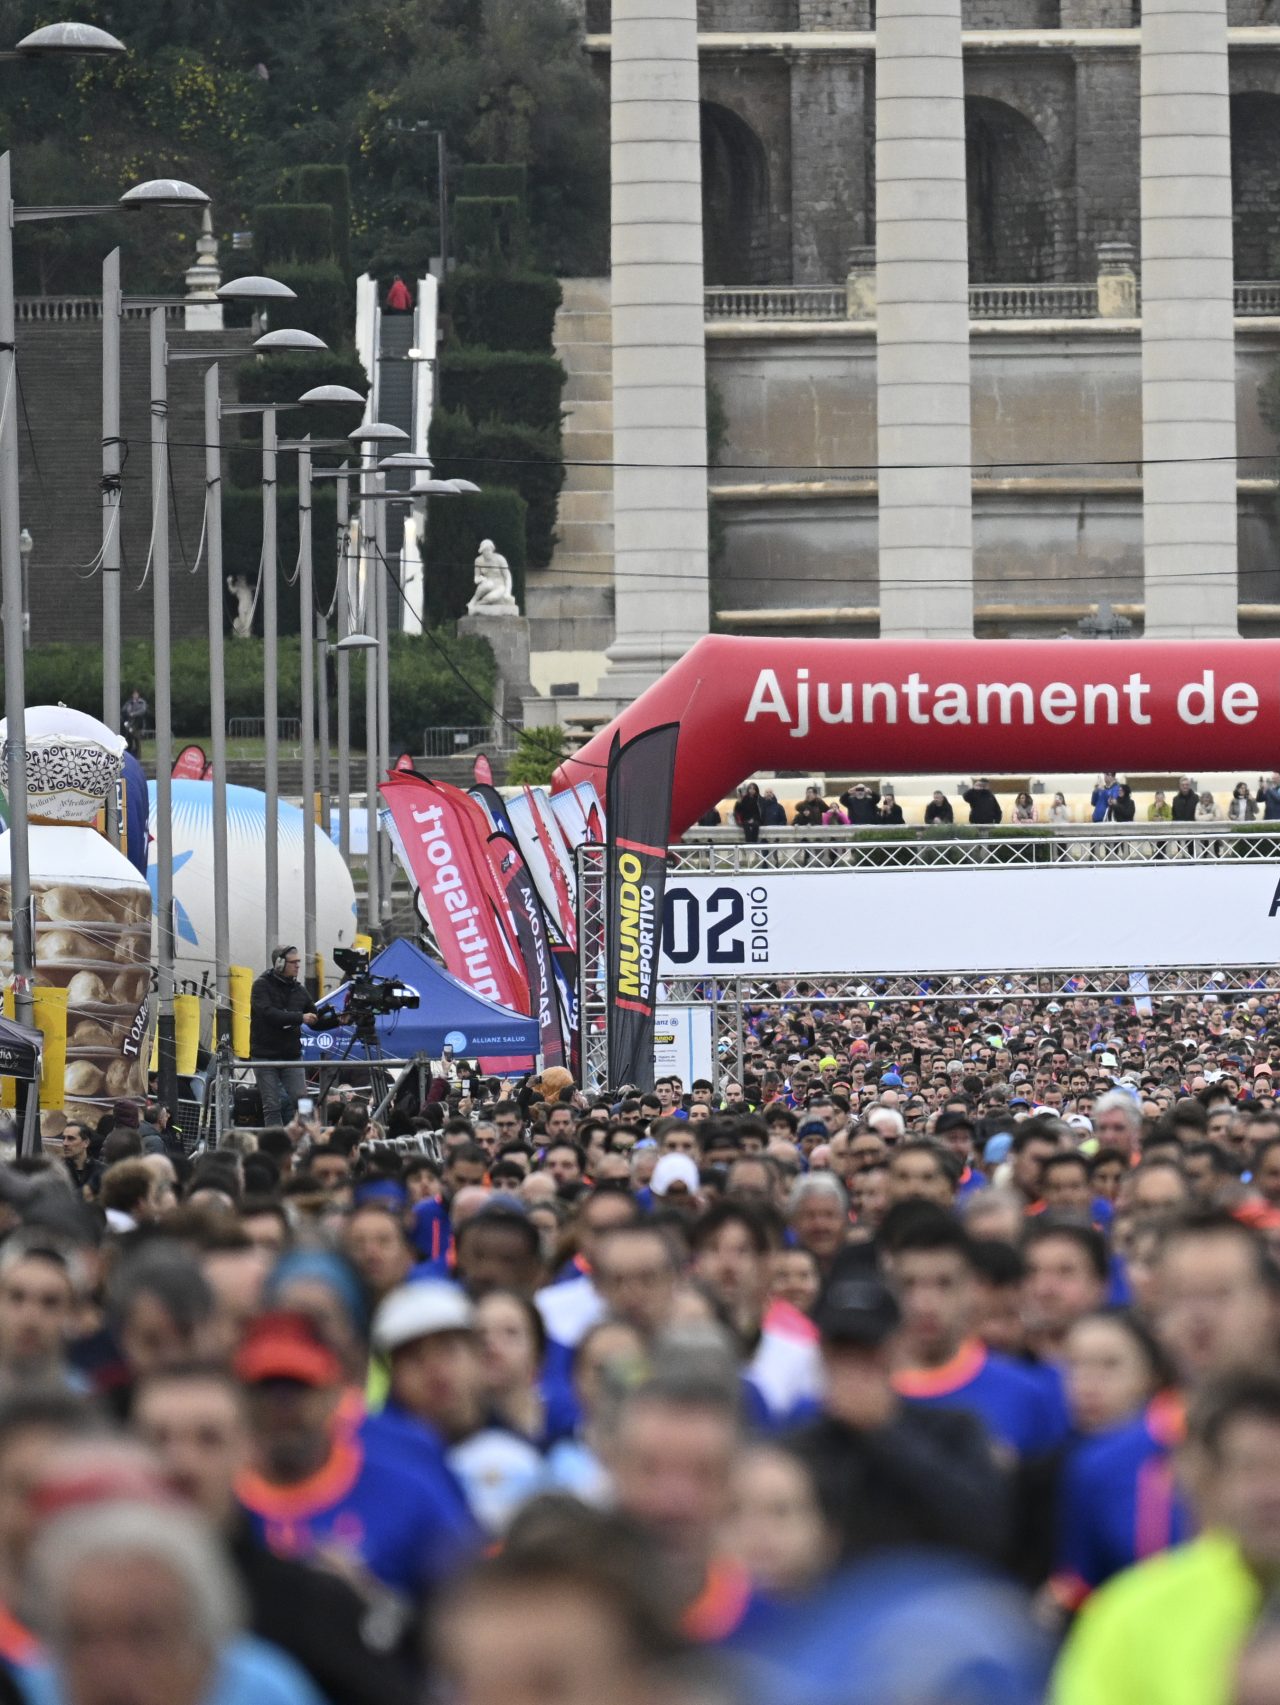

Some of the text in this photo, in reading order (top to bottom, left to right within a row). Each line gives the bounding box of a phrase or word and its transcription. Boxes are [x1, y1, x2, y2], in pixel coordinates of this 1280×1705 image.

[744, 668, 1150, 738] Ajuntament
[1176, 669, 1258, 726] de
[618, 852, 642, 997] MUNDO
[639, 885, 655, 1000] DEPORTIVO
[662, 887, 745, 964] 02
[747, 886, 769, 963] EDICIÓ
[472, 1036, 501, 1044] ALLIANZ
